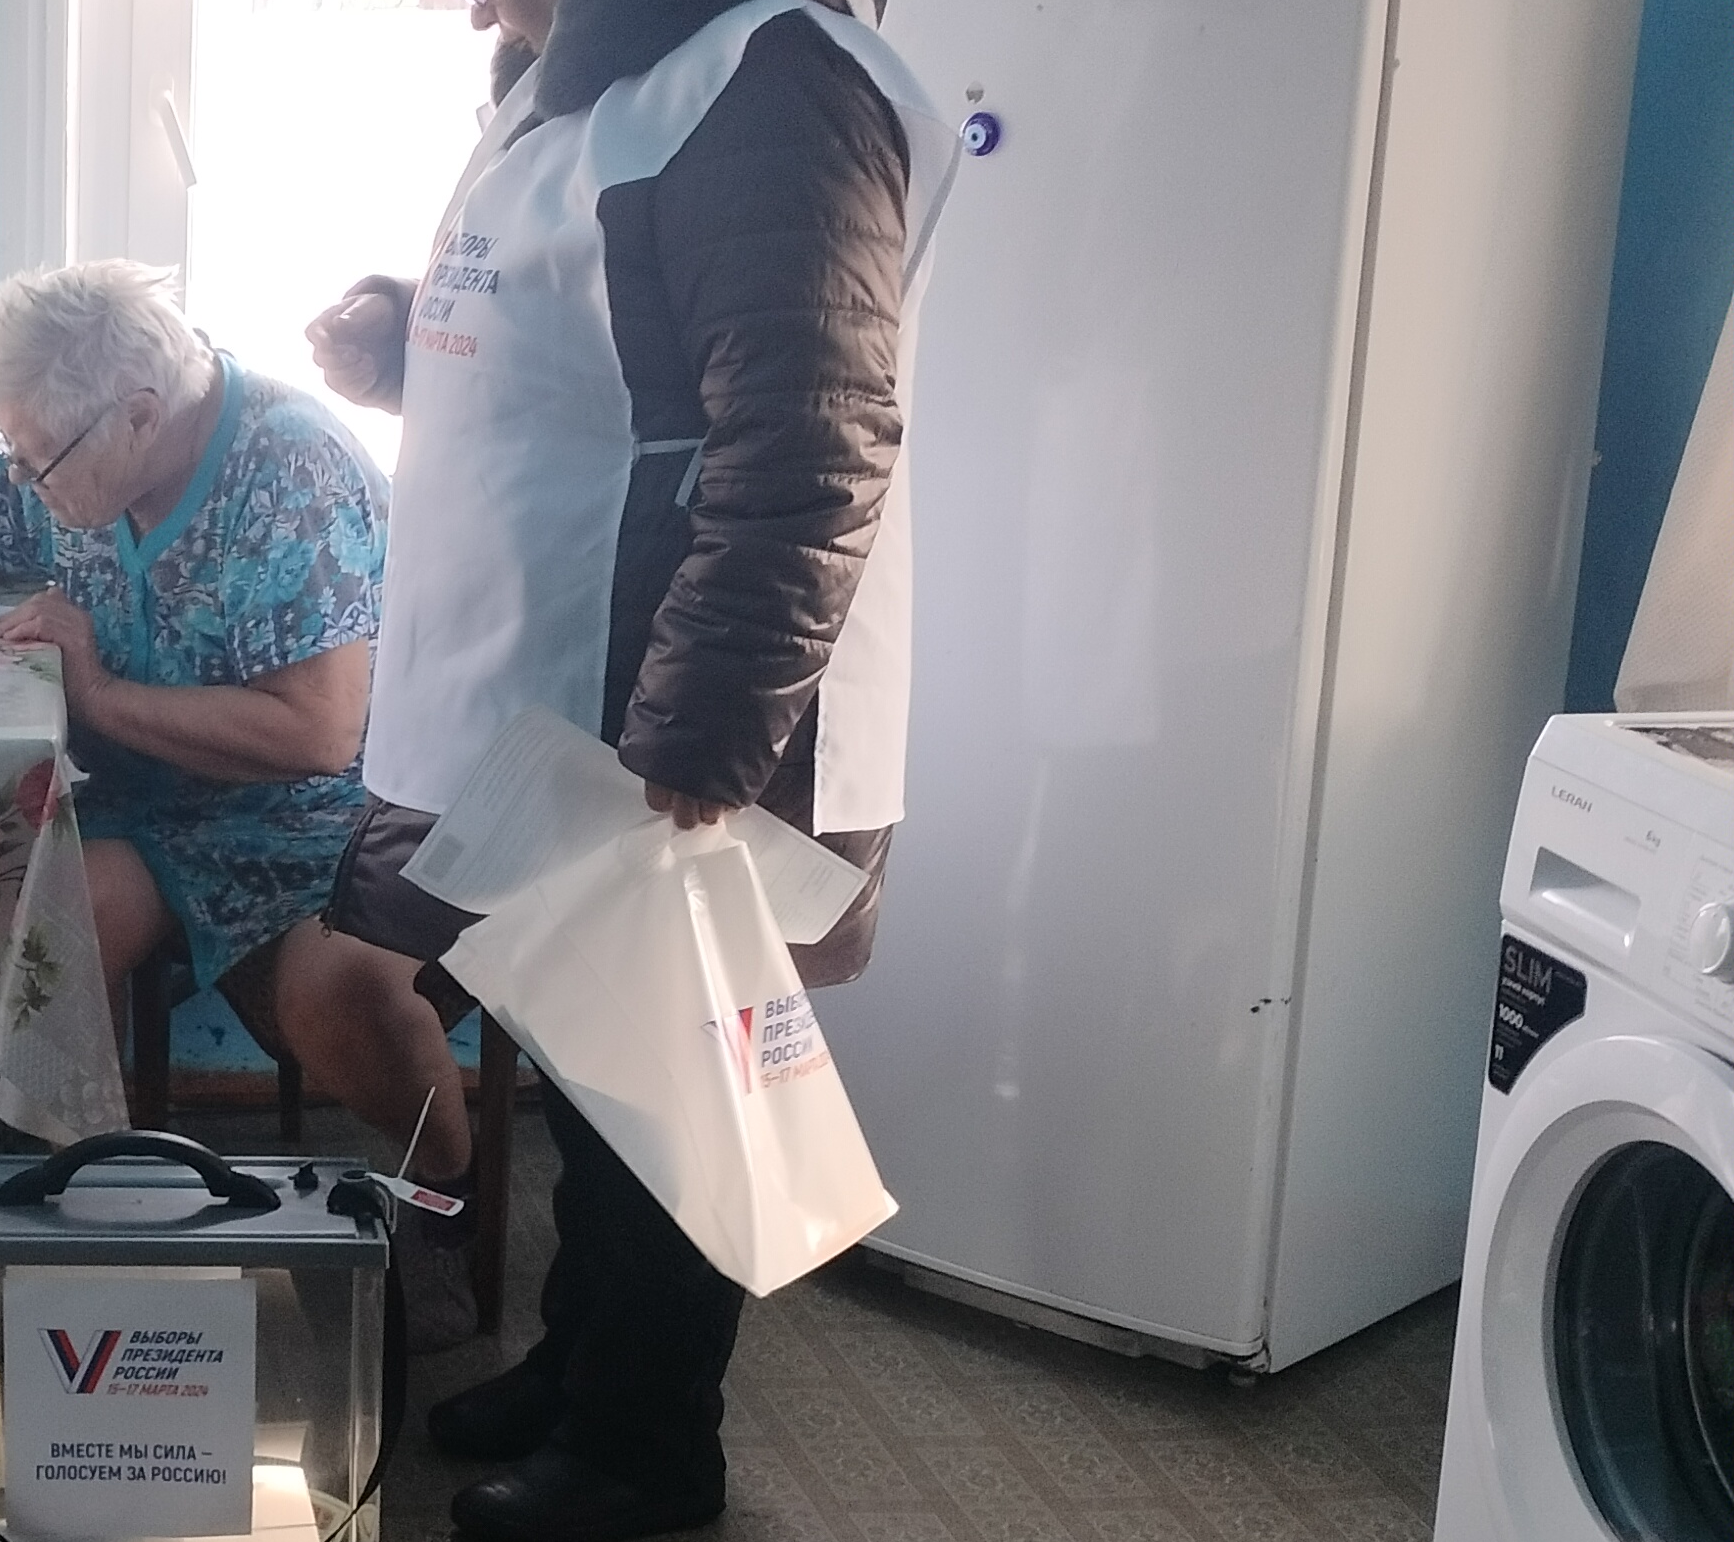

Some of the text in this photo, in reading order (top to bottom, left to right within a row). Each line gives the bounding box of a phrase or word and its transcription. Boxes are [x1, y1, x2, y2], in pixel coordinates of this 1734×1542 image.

[1504, 945, 1553, 995] SLIM
[129, 1330, 203, 1346] ВЫБОРЫ
[120, 1348, 224, 1365] ПРЕЗИДЕНТА
[112, 1366, 180, 1380] РОССИИ
[139, 1384, 179, 1397] МАРТА
[180, 1385, 209, 1397] 2024
[50, 1442, 115, 1459] ВМЕСТЕ
[119, 1443, 148, 1460] МЫ
[152, 1444, 197, 1461] СИЛА
[35, 1465, 227, 1485] ГОЛОСУЕМ ЗА РОССИЮ!
